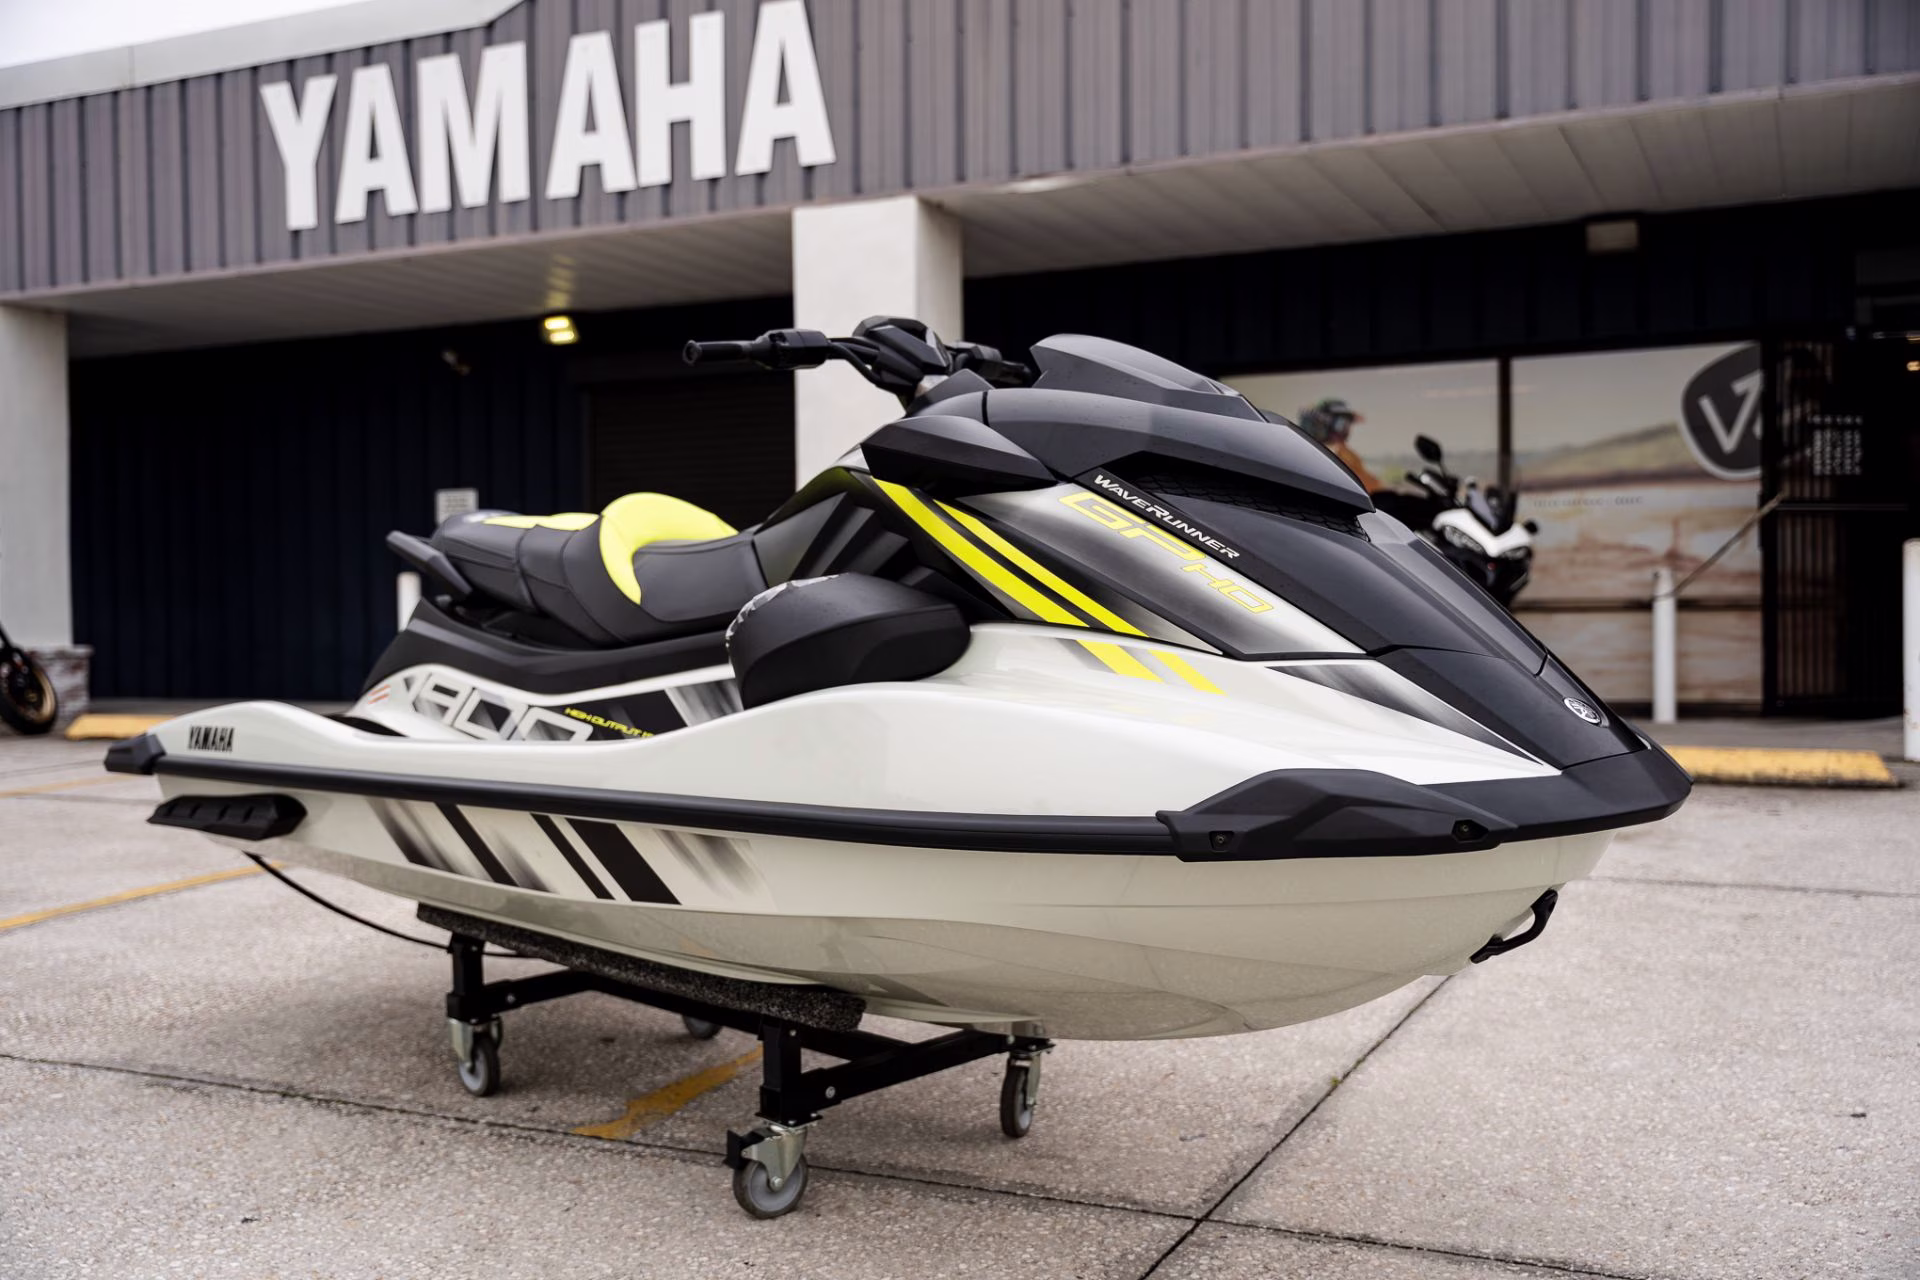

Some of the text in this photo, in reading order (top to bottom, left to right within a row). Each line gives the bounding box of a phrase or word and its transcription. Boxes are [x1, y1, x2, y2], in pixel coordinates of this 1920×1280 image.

[259, 0, 837, 231] YAMAHA
[1059, 491, 1275, 615] GP HO
[1094, 474, 1241, 559] WAVERUNNER
[188, 725, 236, 752] YAMAHA
[590, 715, 643, 737] OUTPUT
